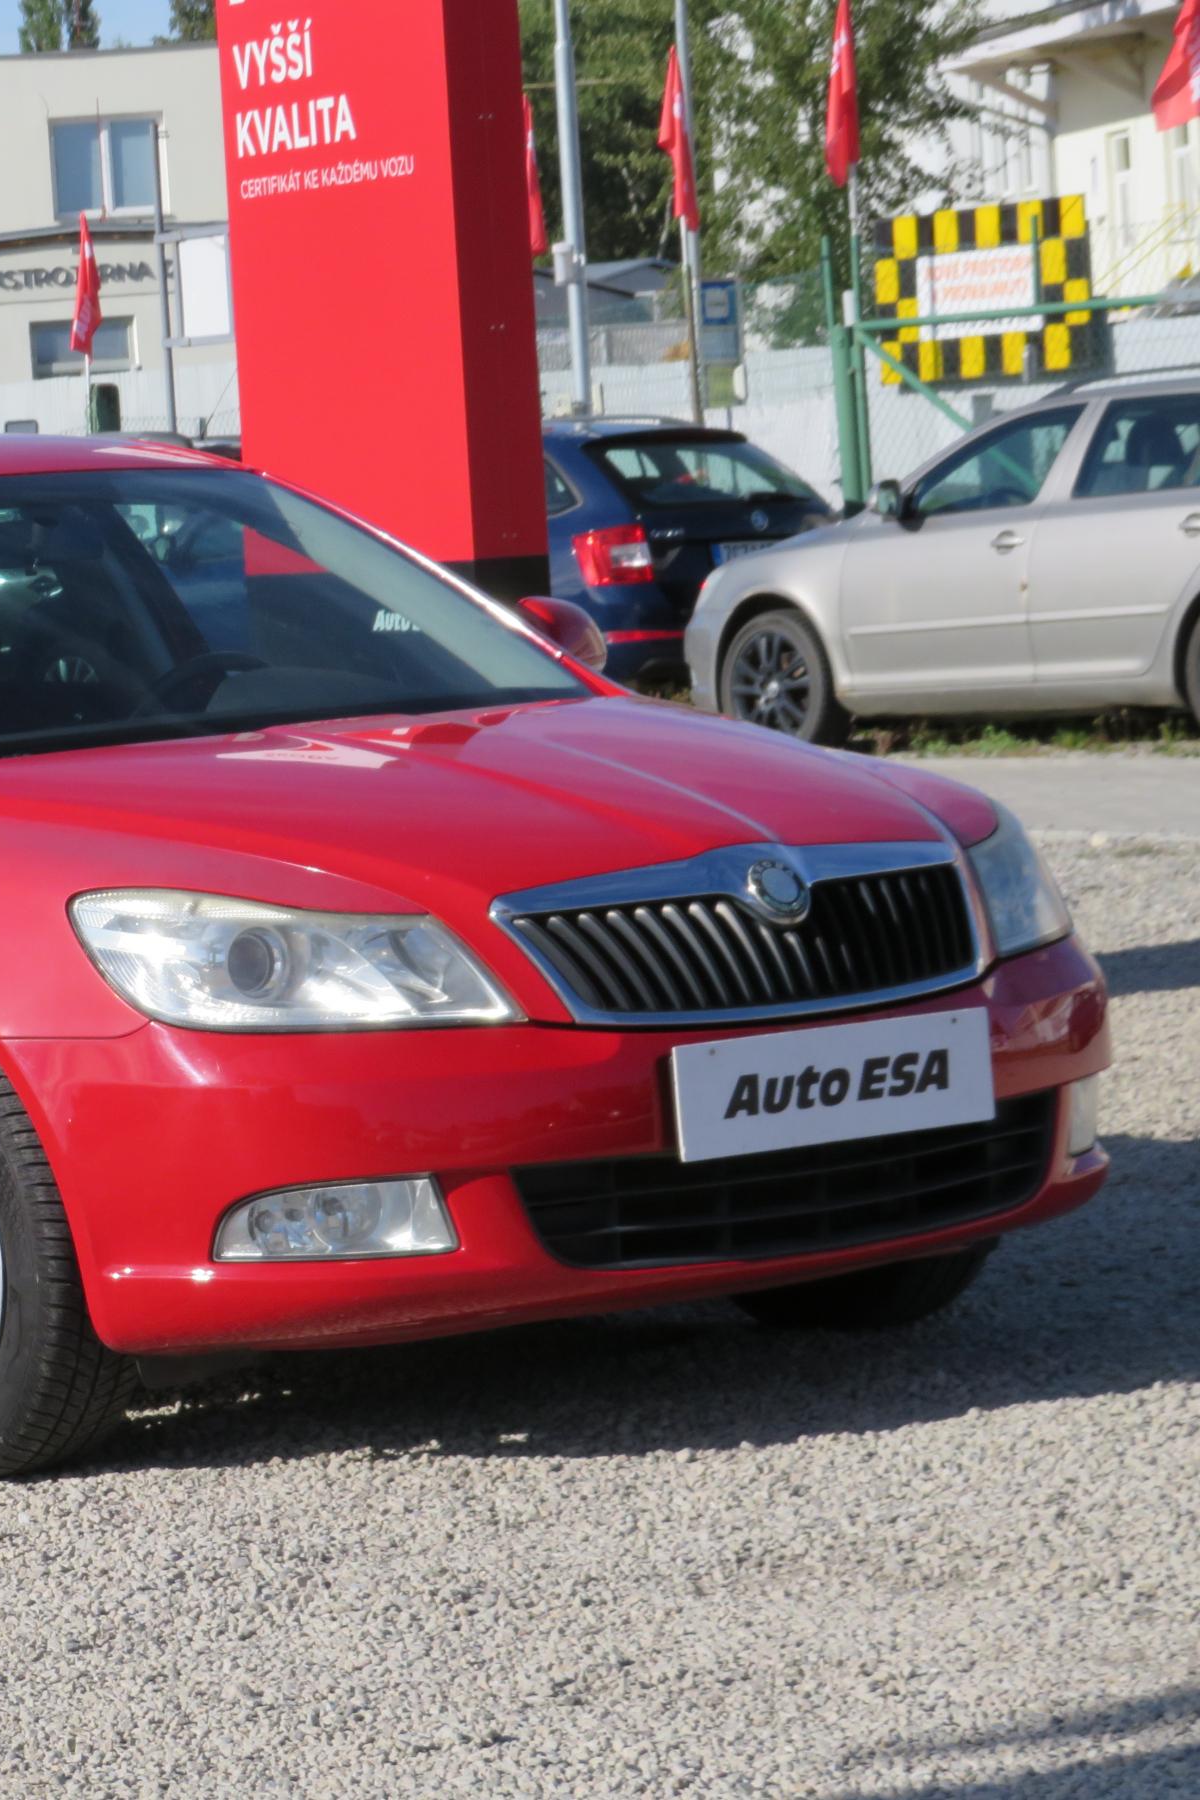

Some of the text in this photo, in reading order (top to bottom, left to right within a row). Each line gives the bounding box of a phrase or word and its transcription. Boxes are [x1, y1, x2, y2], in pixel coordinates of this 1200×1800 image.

[232, 17, 313, 90] VYŠŠÍ
[235, 94, 357, 159] KVALITA
[240, 155, 414, 200] CERTIFIKÁT KE KAŽDÉMU VOZU
[724, 1048, 949, 1119] Auto ESA
